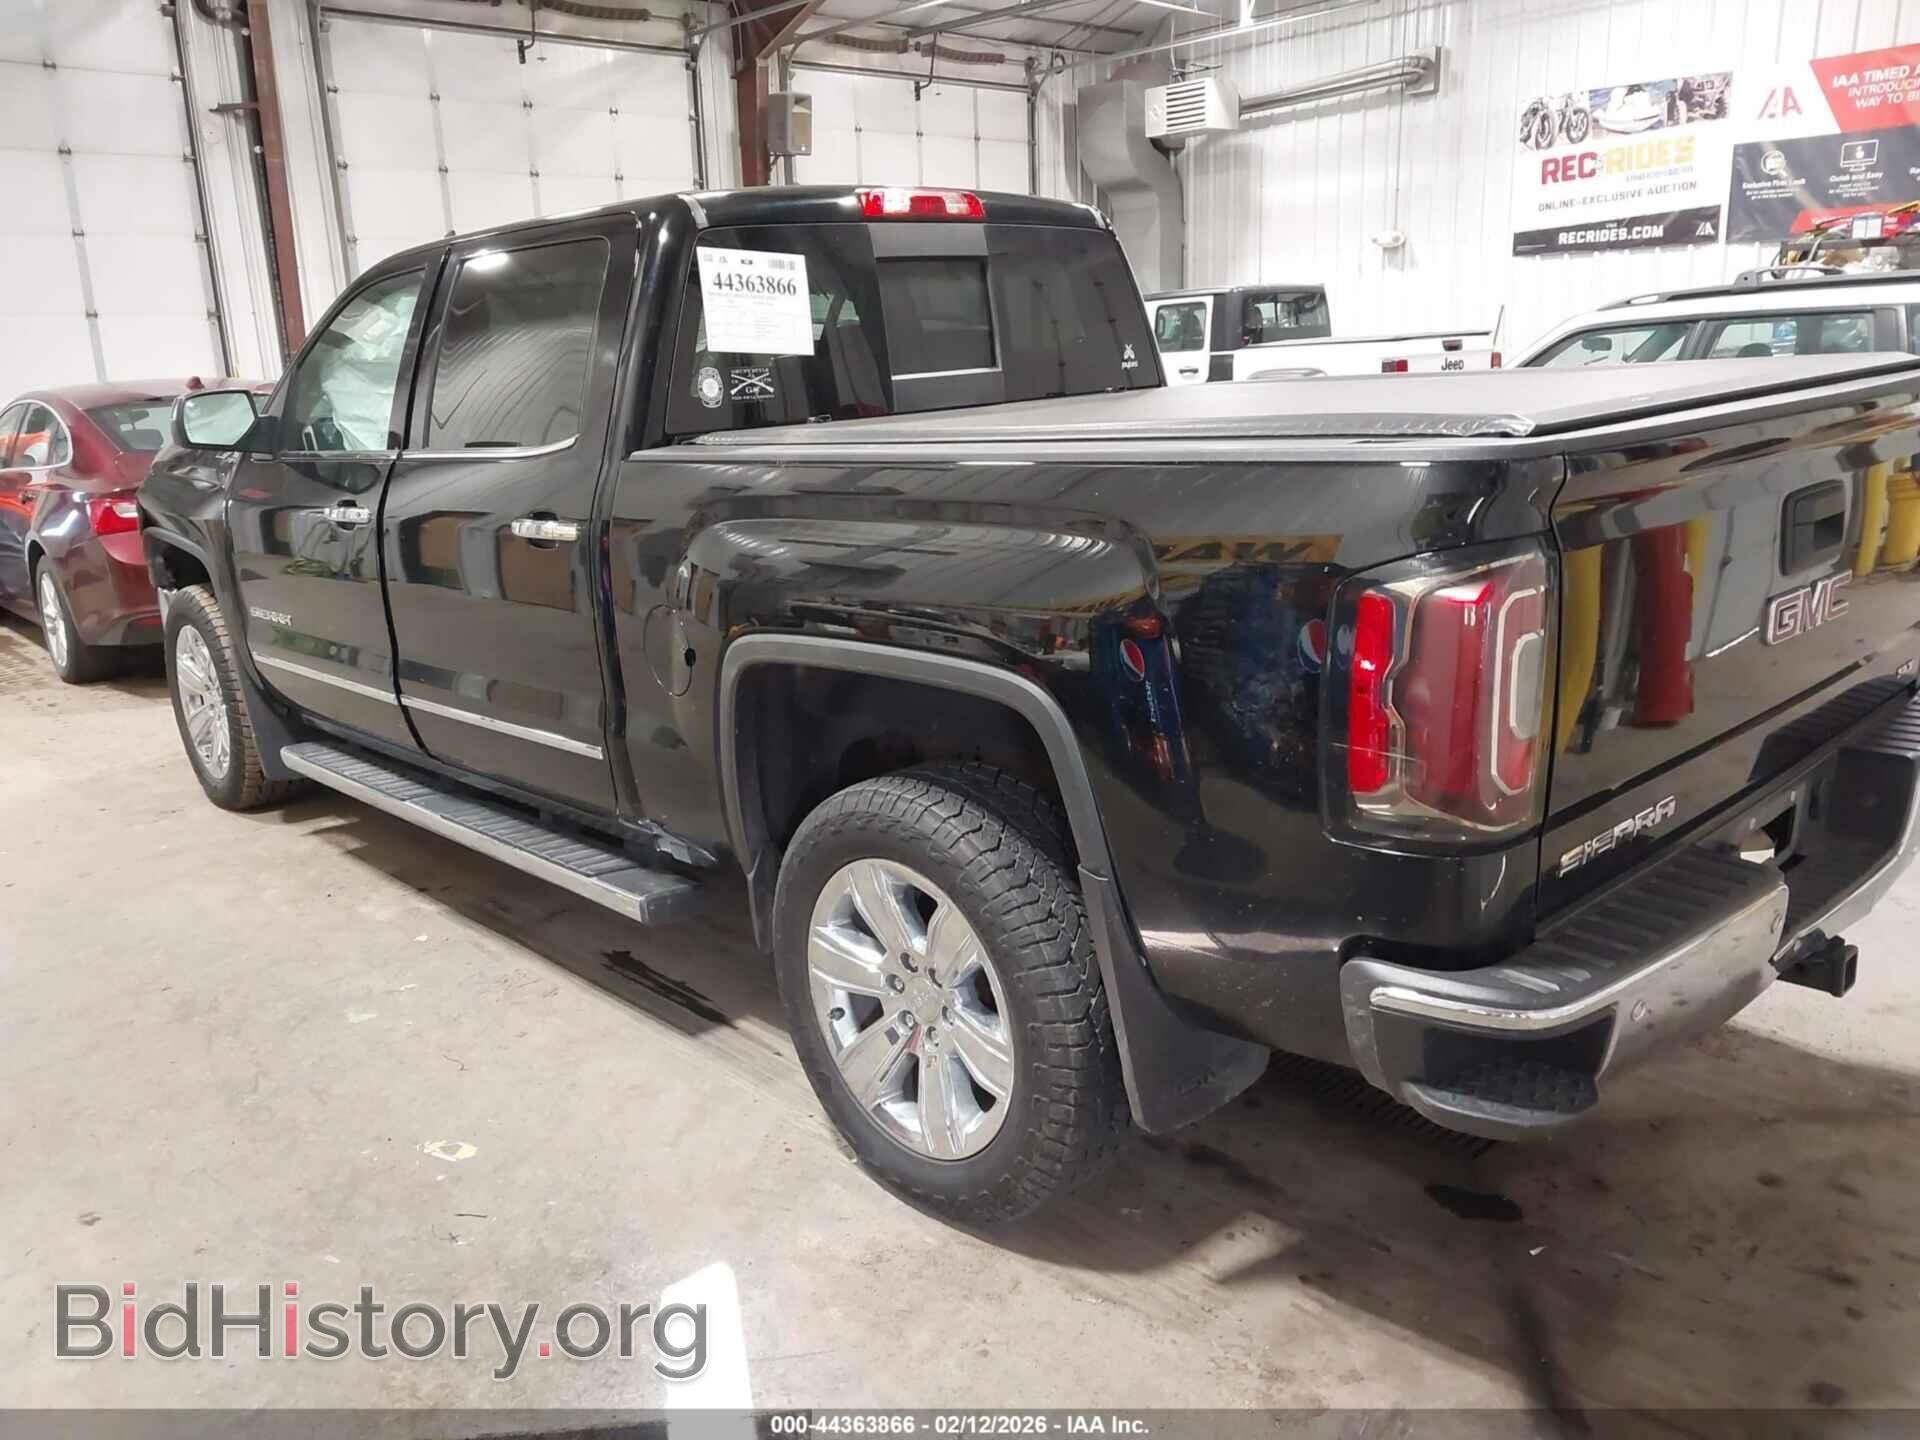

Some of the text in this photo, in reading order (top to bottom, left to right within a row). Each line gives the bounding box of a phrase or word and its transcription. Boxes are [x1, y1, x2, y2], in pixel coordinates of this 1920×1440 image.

[1864, 65, 1909, 82] TIMED
[1855, 96, 1883, 109] WAY
[1887, 92, 1904, 104] TO
[1541, 151, 1598, 185] REC
[1538, 180, 1697, 212] ONLINE-EXCLUSIVE AUCTION
[1558, 224, 1664, 245] RECRIDES.COM
[713, 272, 797, 296] 44363866
[1441, 357, 1464, 371] Jeep
[1767, 569, 1853, 645] GMC
[1559, 795, 1677, 878] SIERRA
